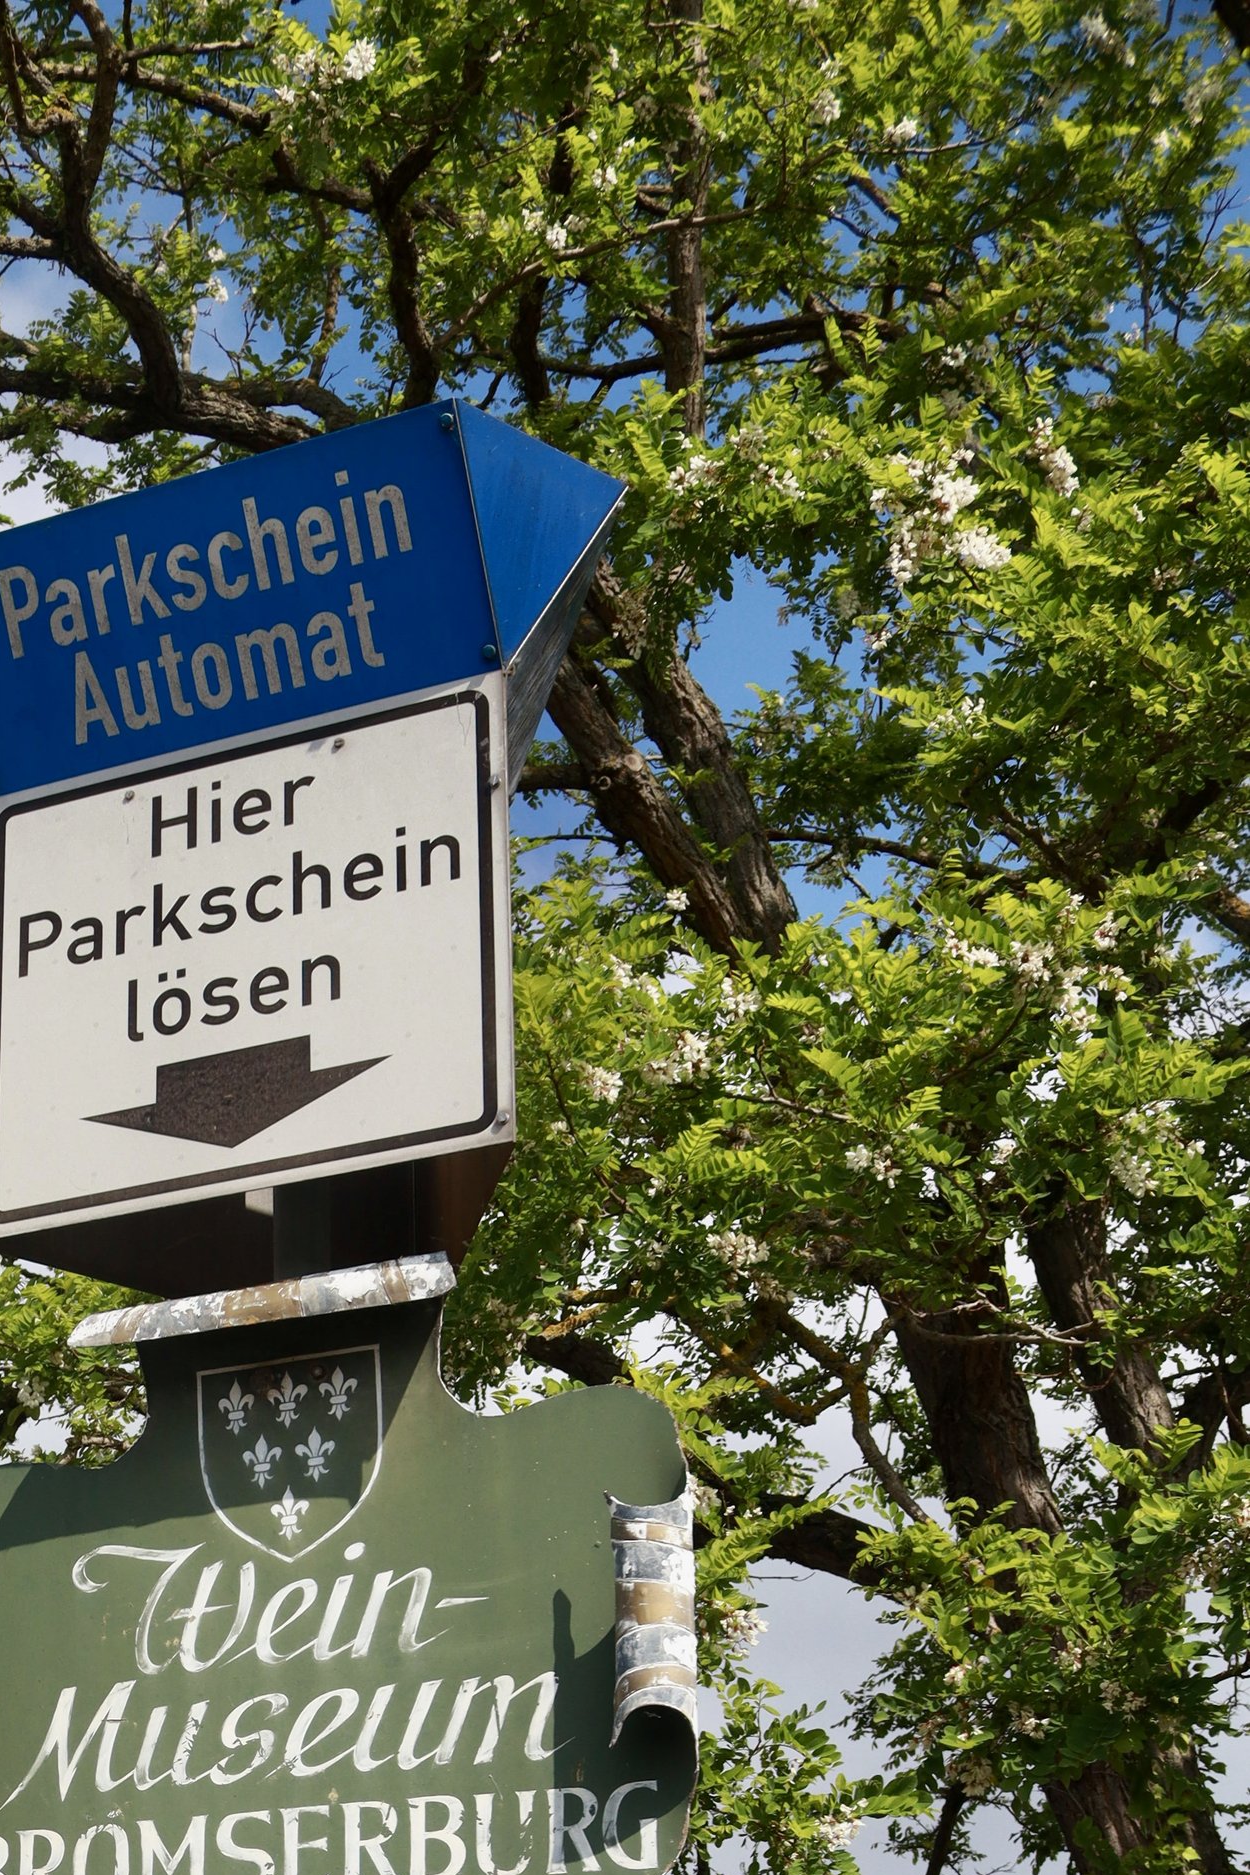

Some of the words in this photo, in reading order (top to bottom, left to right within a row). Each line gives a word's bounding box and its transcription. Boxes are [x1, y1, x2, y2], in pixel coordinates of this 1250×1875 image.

[73, 580, 386, 746] Automat
[151, 774, 316, 858] Hier
[19, 826, 460, 978] Parkschein
[128, 953, 341, 1043] lösen
[72, 1541, 489, 1675] Wein-
